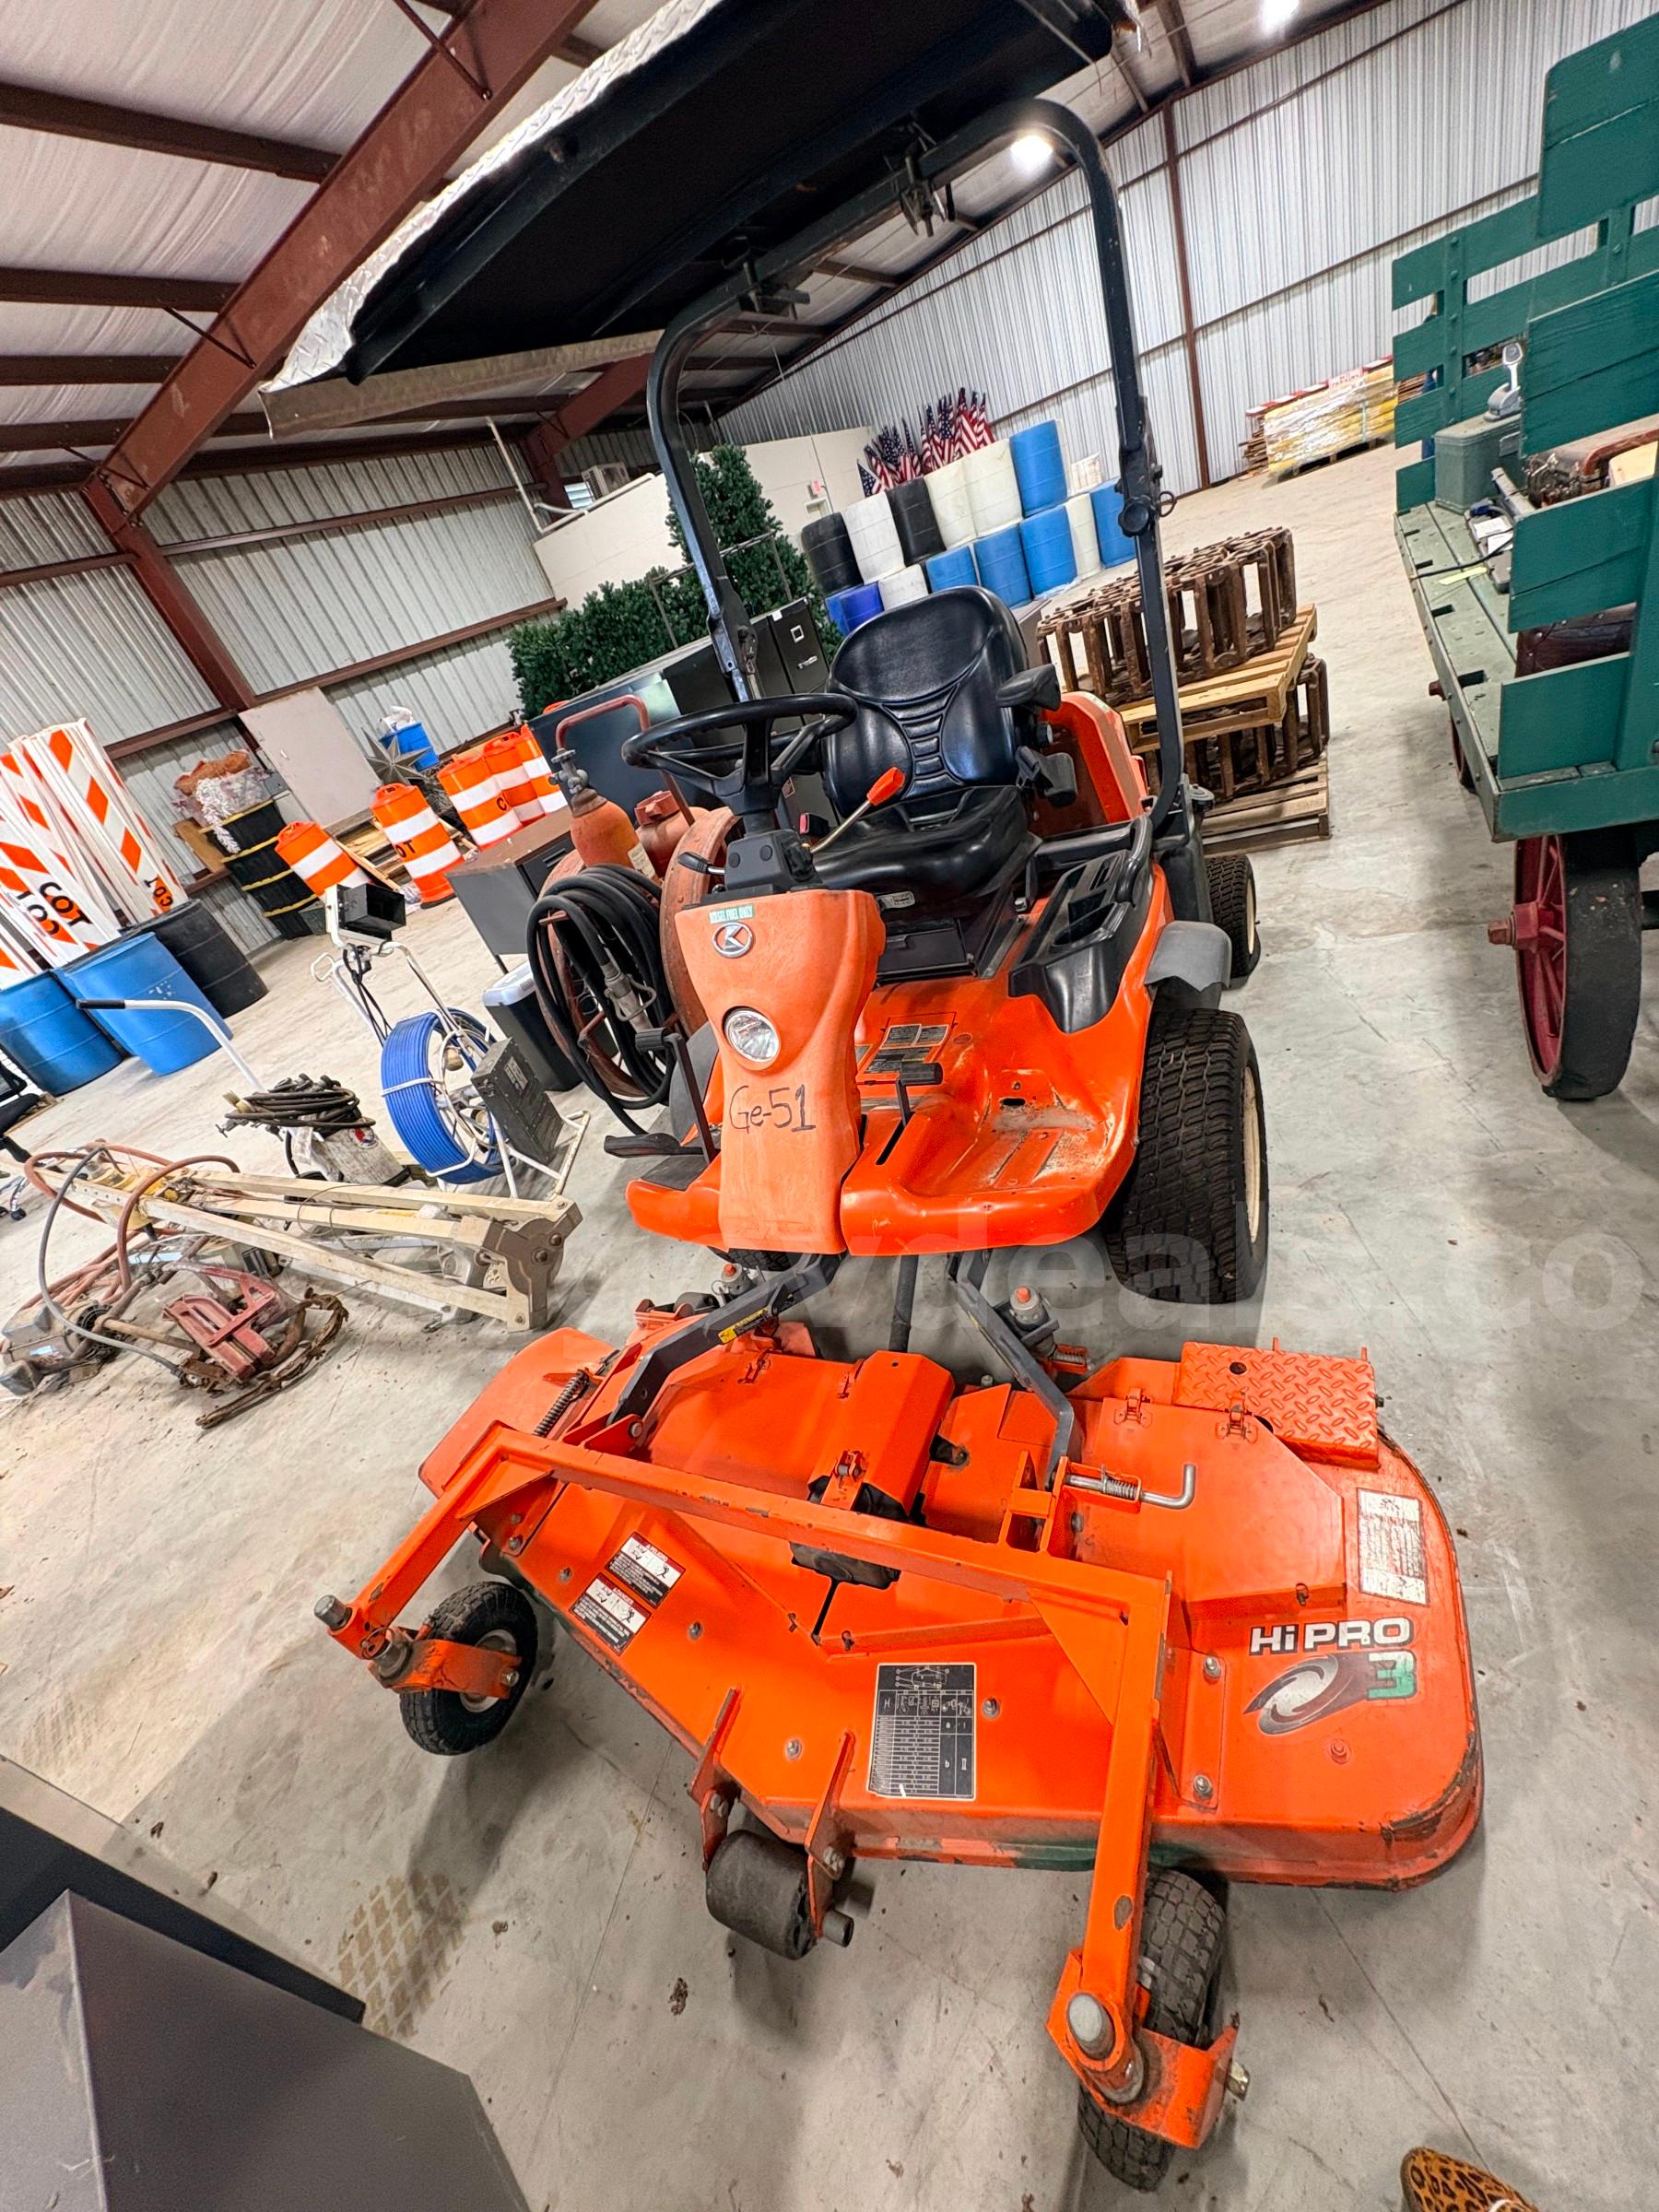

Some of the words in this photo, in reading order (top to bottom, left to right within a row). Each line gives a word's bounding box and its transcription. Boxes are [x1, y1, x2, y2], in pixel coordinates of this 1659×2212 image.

[39, 881, 94, 928] COT
[1249, 1623, 1299, 1655] Hi
[1303, 1617, 1414, 1653] PRO
[1367, 1649, 1418, 1701] 3
